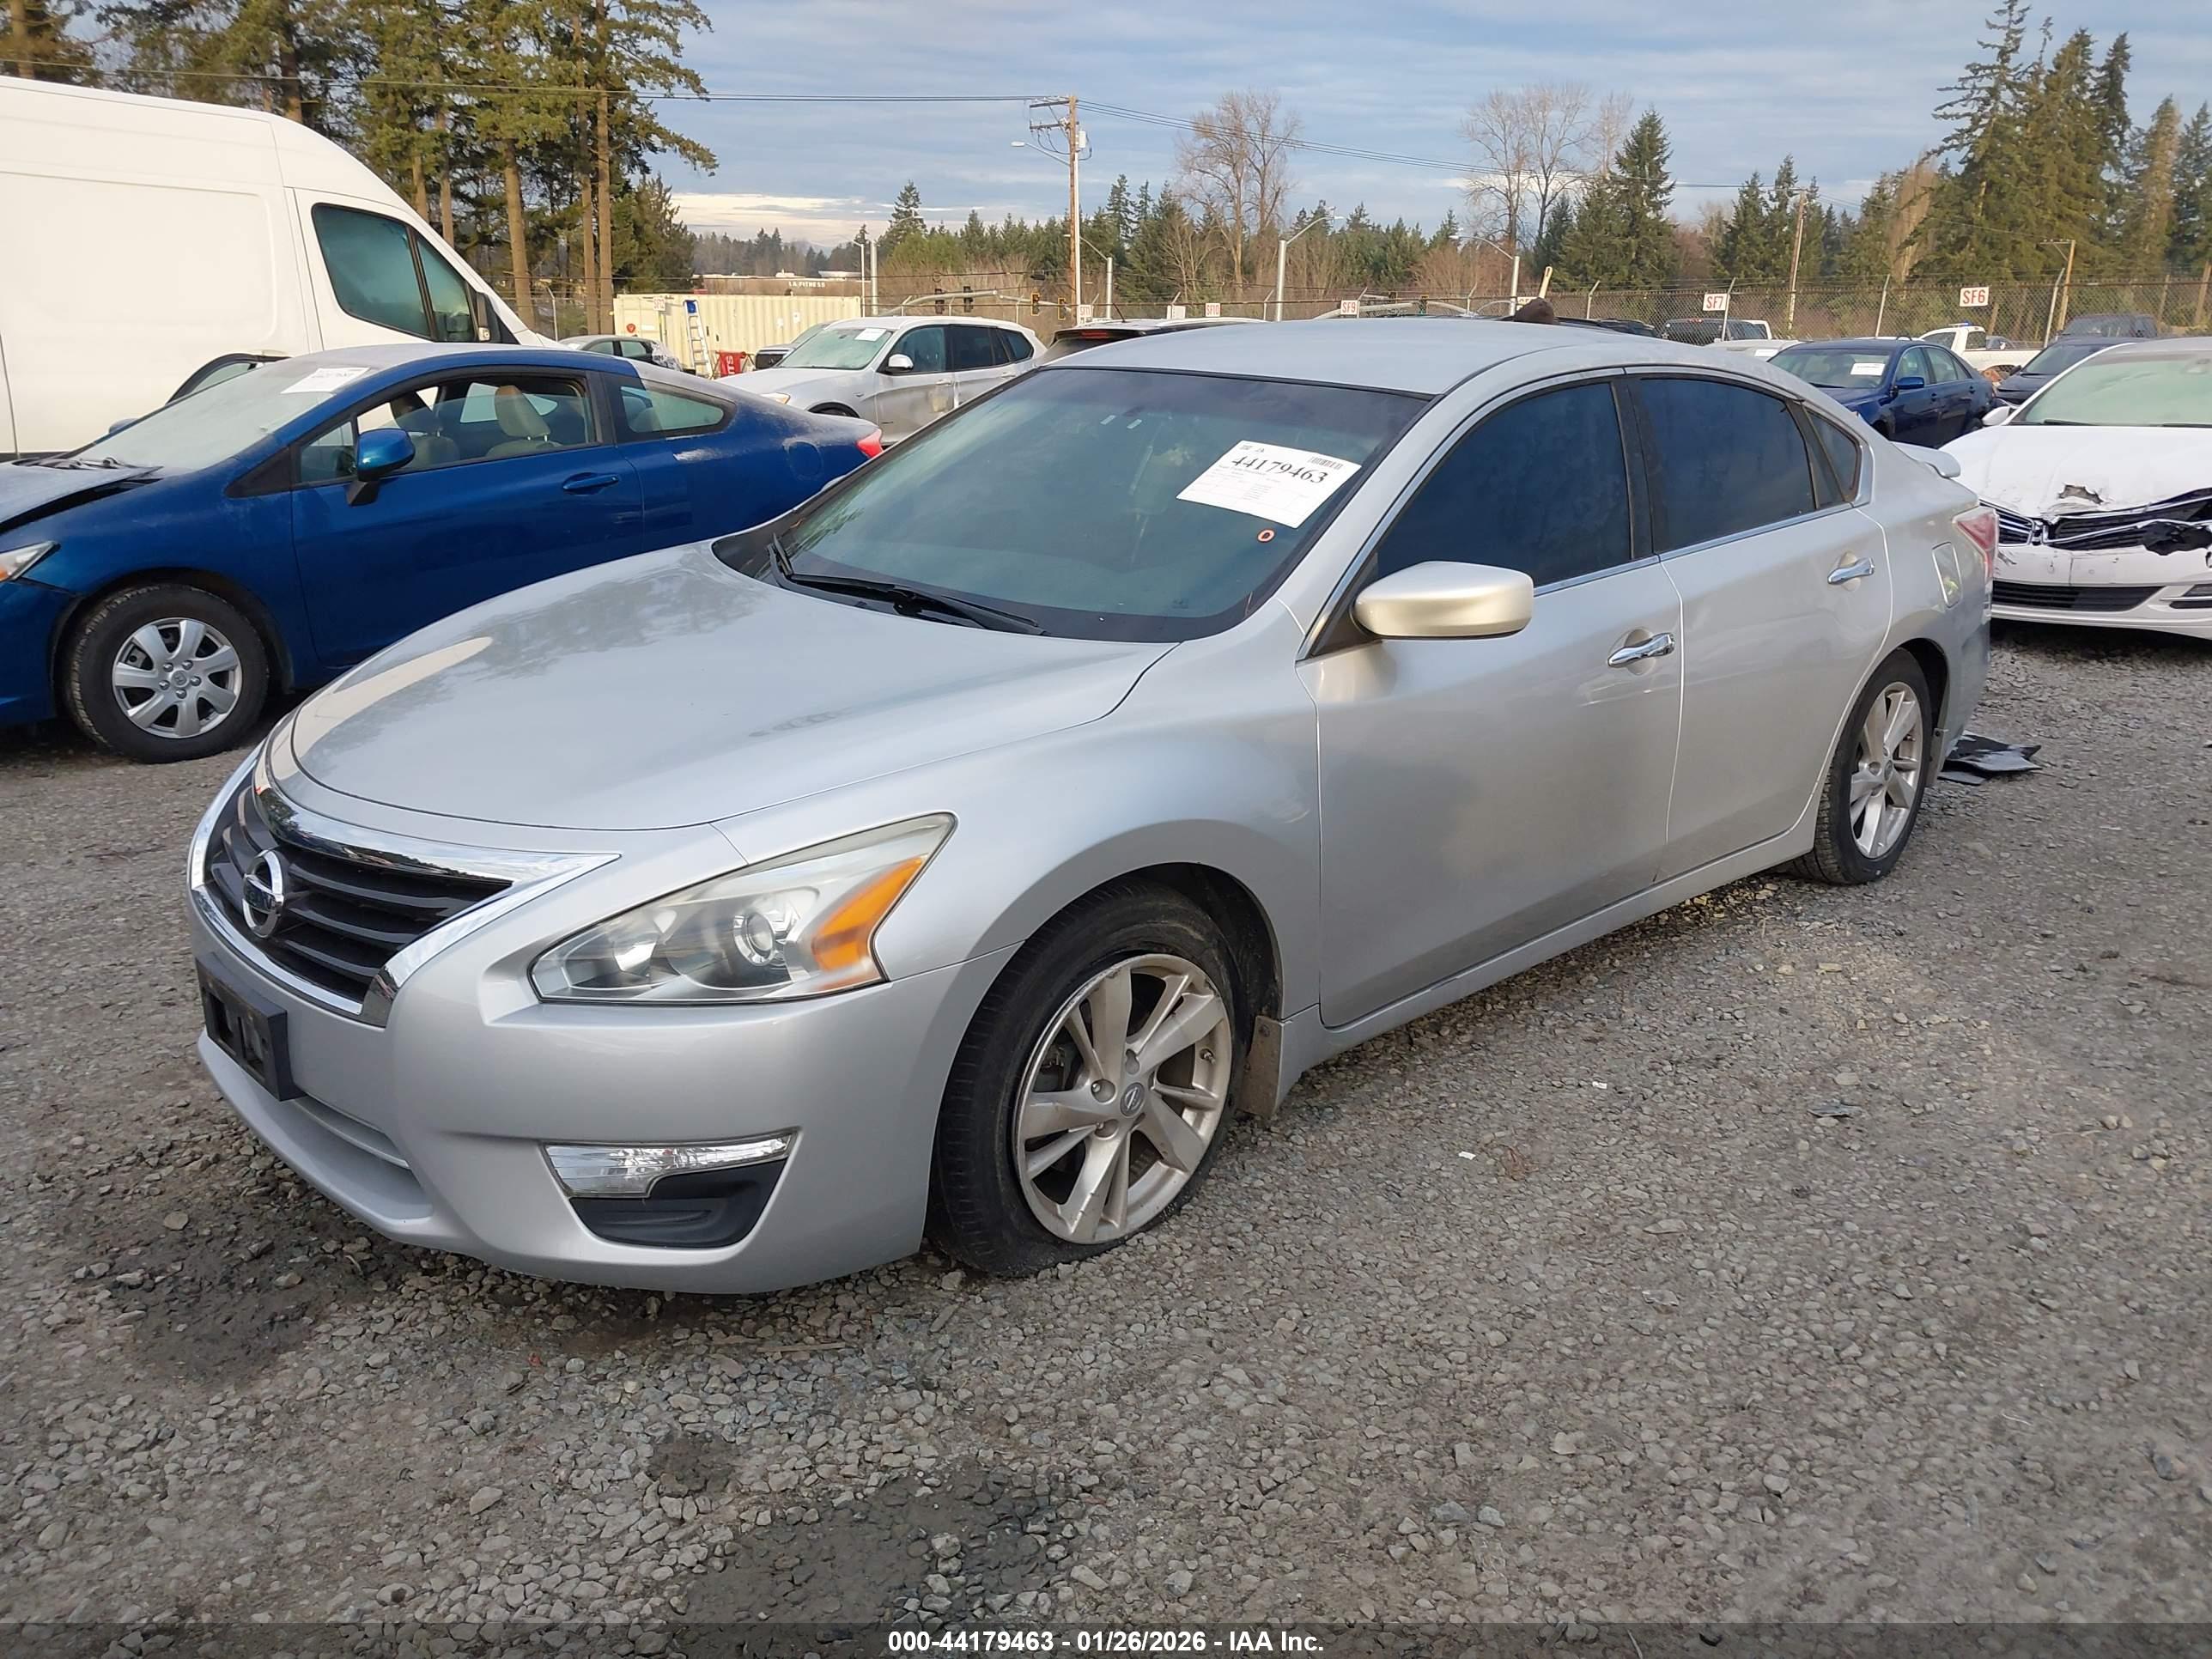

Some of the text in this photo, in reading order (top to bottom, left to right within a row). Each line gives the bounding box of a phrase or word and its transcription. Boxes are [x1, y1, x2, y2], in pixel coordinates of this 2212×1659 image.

[1706, 295, 1724, 309] SF7
[1962, 289, 1986, 304] SF6
[1342, 302, 1356, 313] SF9
[1231, 455, 1329, 483] 44179463
